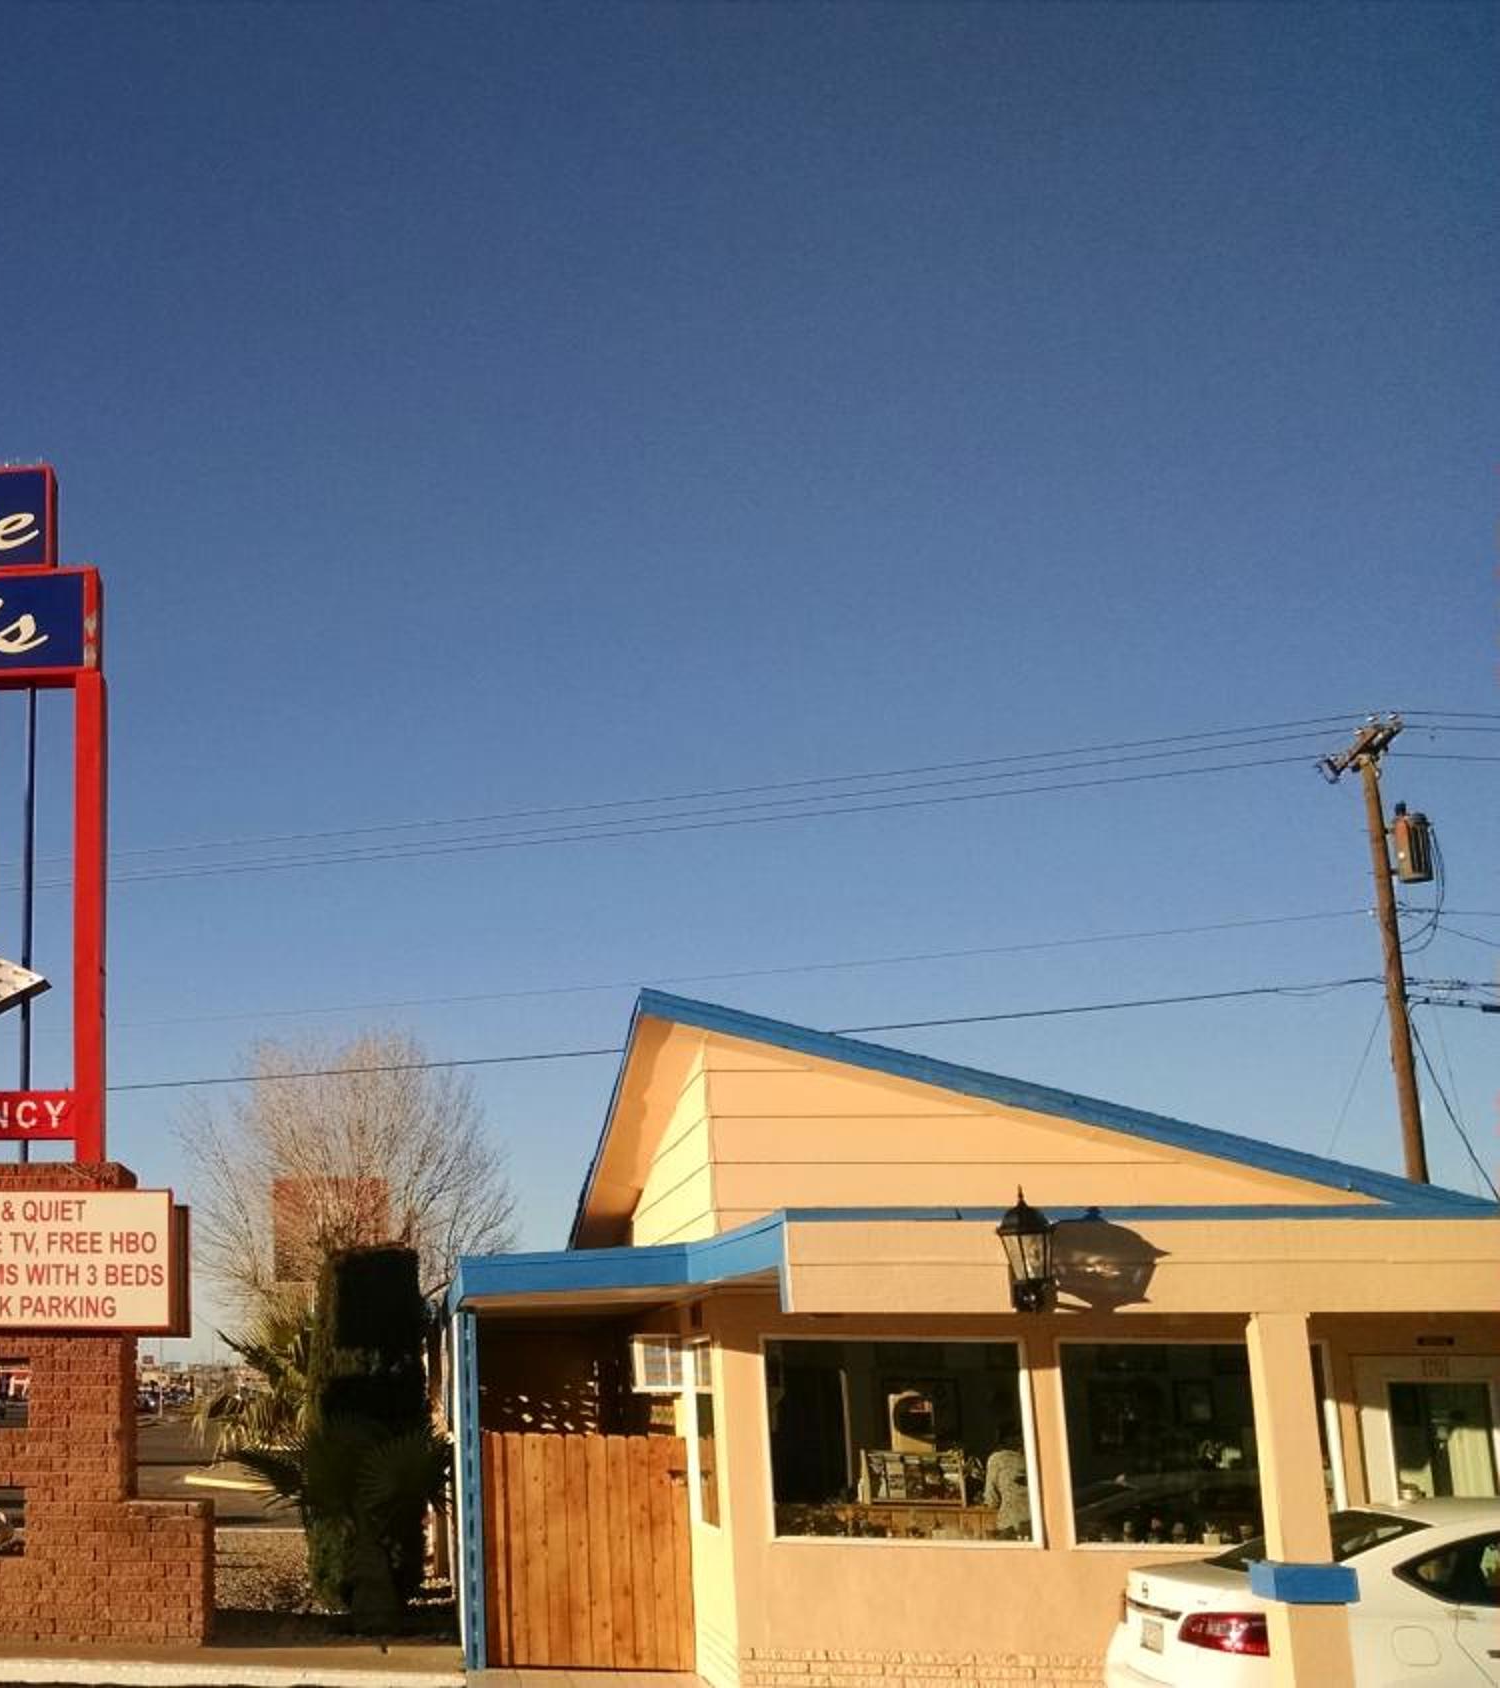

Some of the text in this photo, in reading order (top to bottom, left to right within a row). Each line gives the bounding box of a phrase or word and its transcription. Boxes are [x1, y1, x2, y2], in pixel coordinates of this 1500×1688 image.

[1, 1200, 15, 1222] &
[22, 1200, 87, 1222] QUIET
[10, 1232, 39, 1257] TV,
[47, 1232, 102, 1253] FREE
[110, 1232, 157, 1253] HBO
[26, 1263, 79, 1286] WITH
[87, 1263, 98, 1286] 3
[105, 1263, 164, 1286] BEDS
[20, 1295, 117, 1318] PARKING
